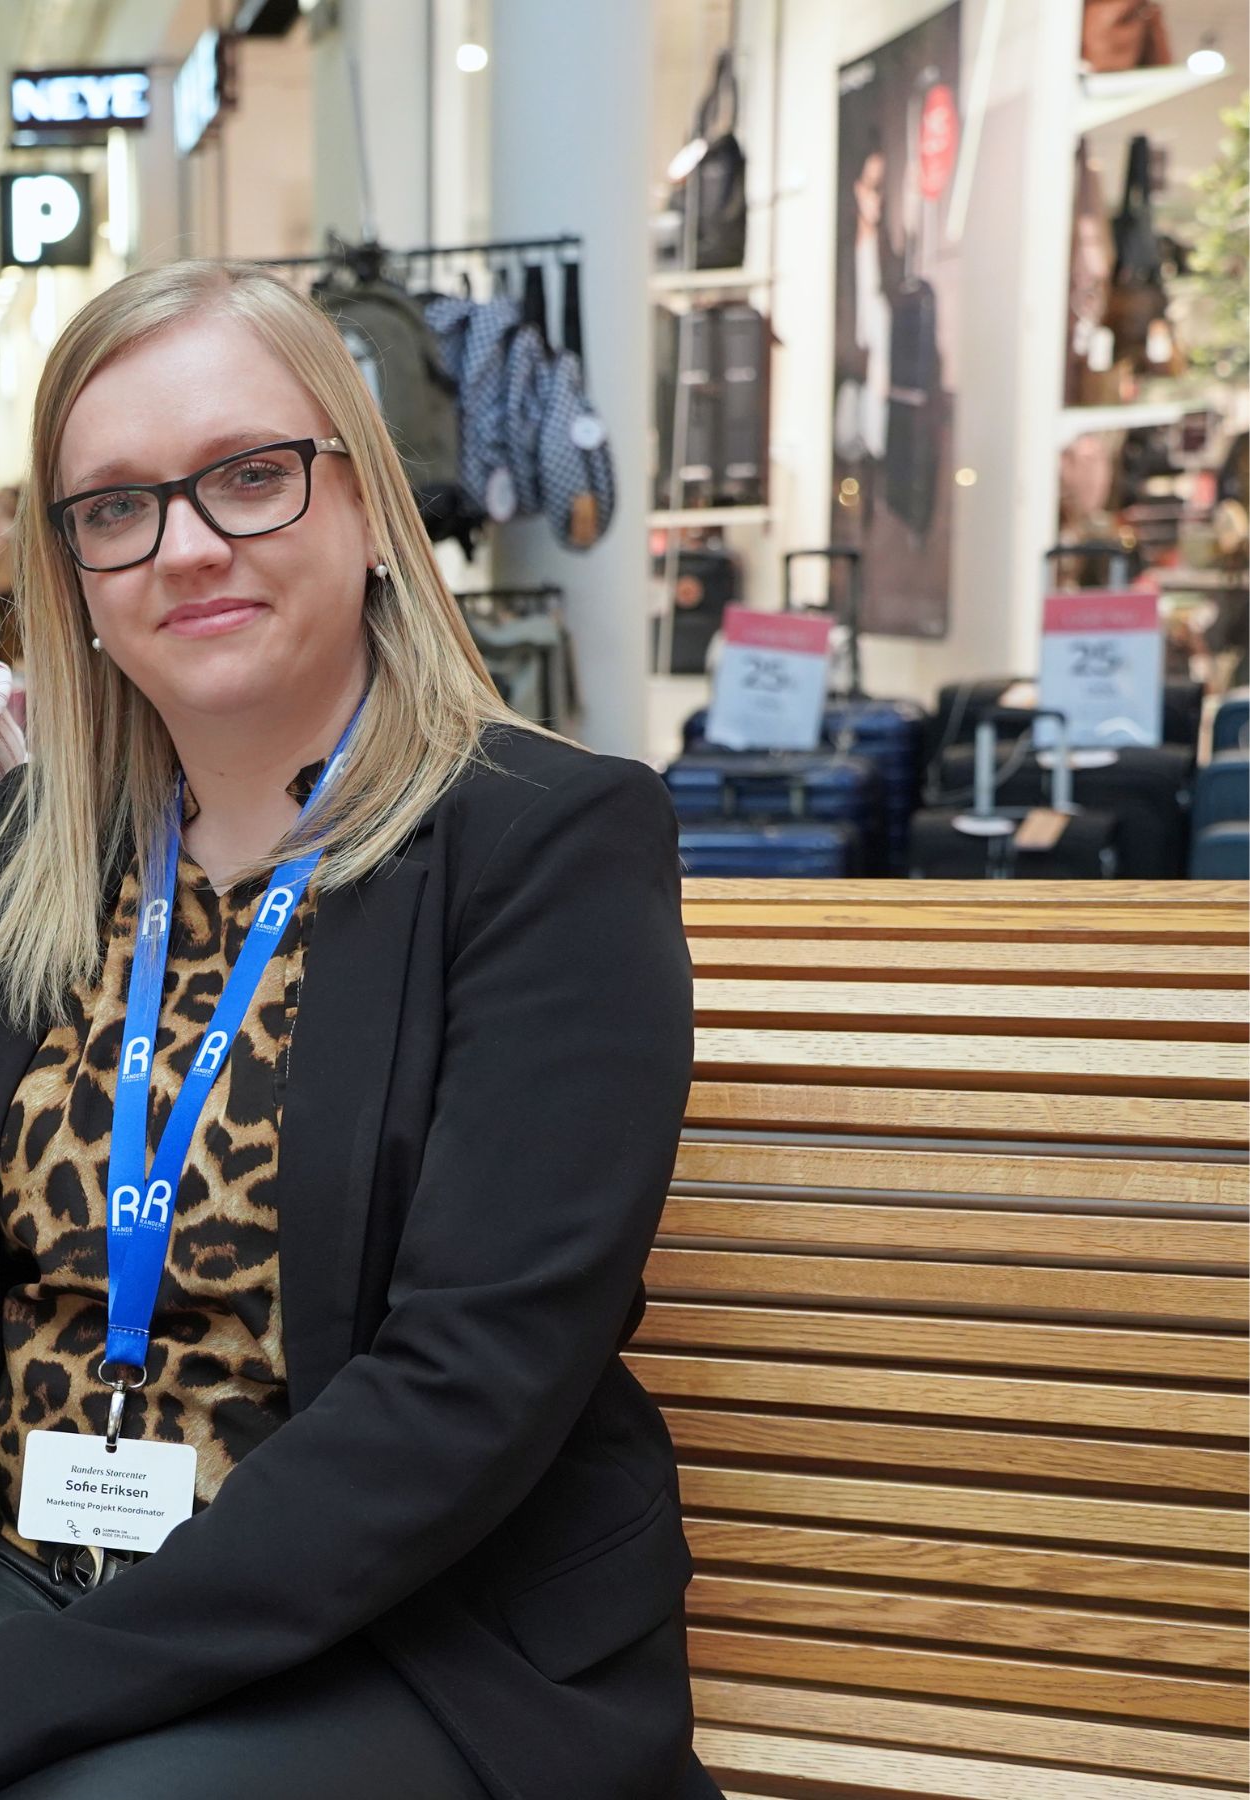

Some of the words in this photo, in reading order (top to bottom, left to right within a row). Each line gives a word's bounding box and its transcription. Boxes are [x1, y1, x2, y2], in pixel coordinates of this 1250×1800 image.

[11, 73, 150, 123] NEYE
[141, 898, 168, 936] R
[258, 887, 294, 927] R
[122, 1036, 150, 1075] R
[195, 1030, 228, 1070] R
[111, 1185, 140, 1227] R
[141, 1179, 172, 1224] R
[139, 1218, 166, 1230] RANDERS
[65, 1479, 97, 1493] Sofie
[100, 1483, 149, 1498] Eriksen
[71, 1464, 104, 1476] Randers
[105, 1468, 147, 1480] Storcenter
[46, 1498, 86, 1509] Marketing
[87, 1502, 116, 1512] Projekt
[117, 1505, 165, 1517] Koordinator
